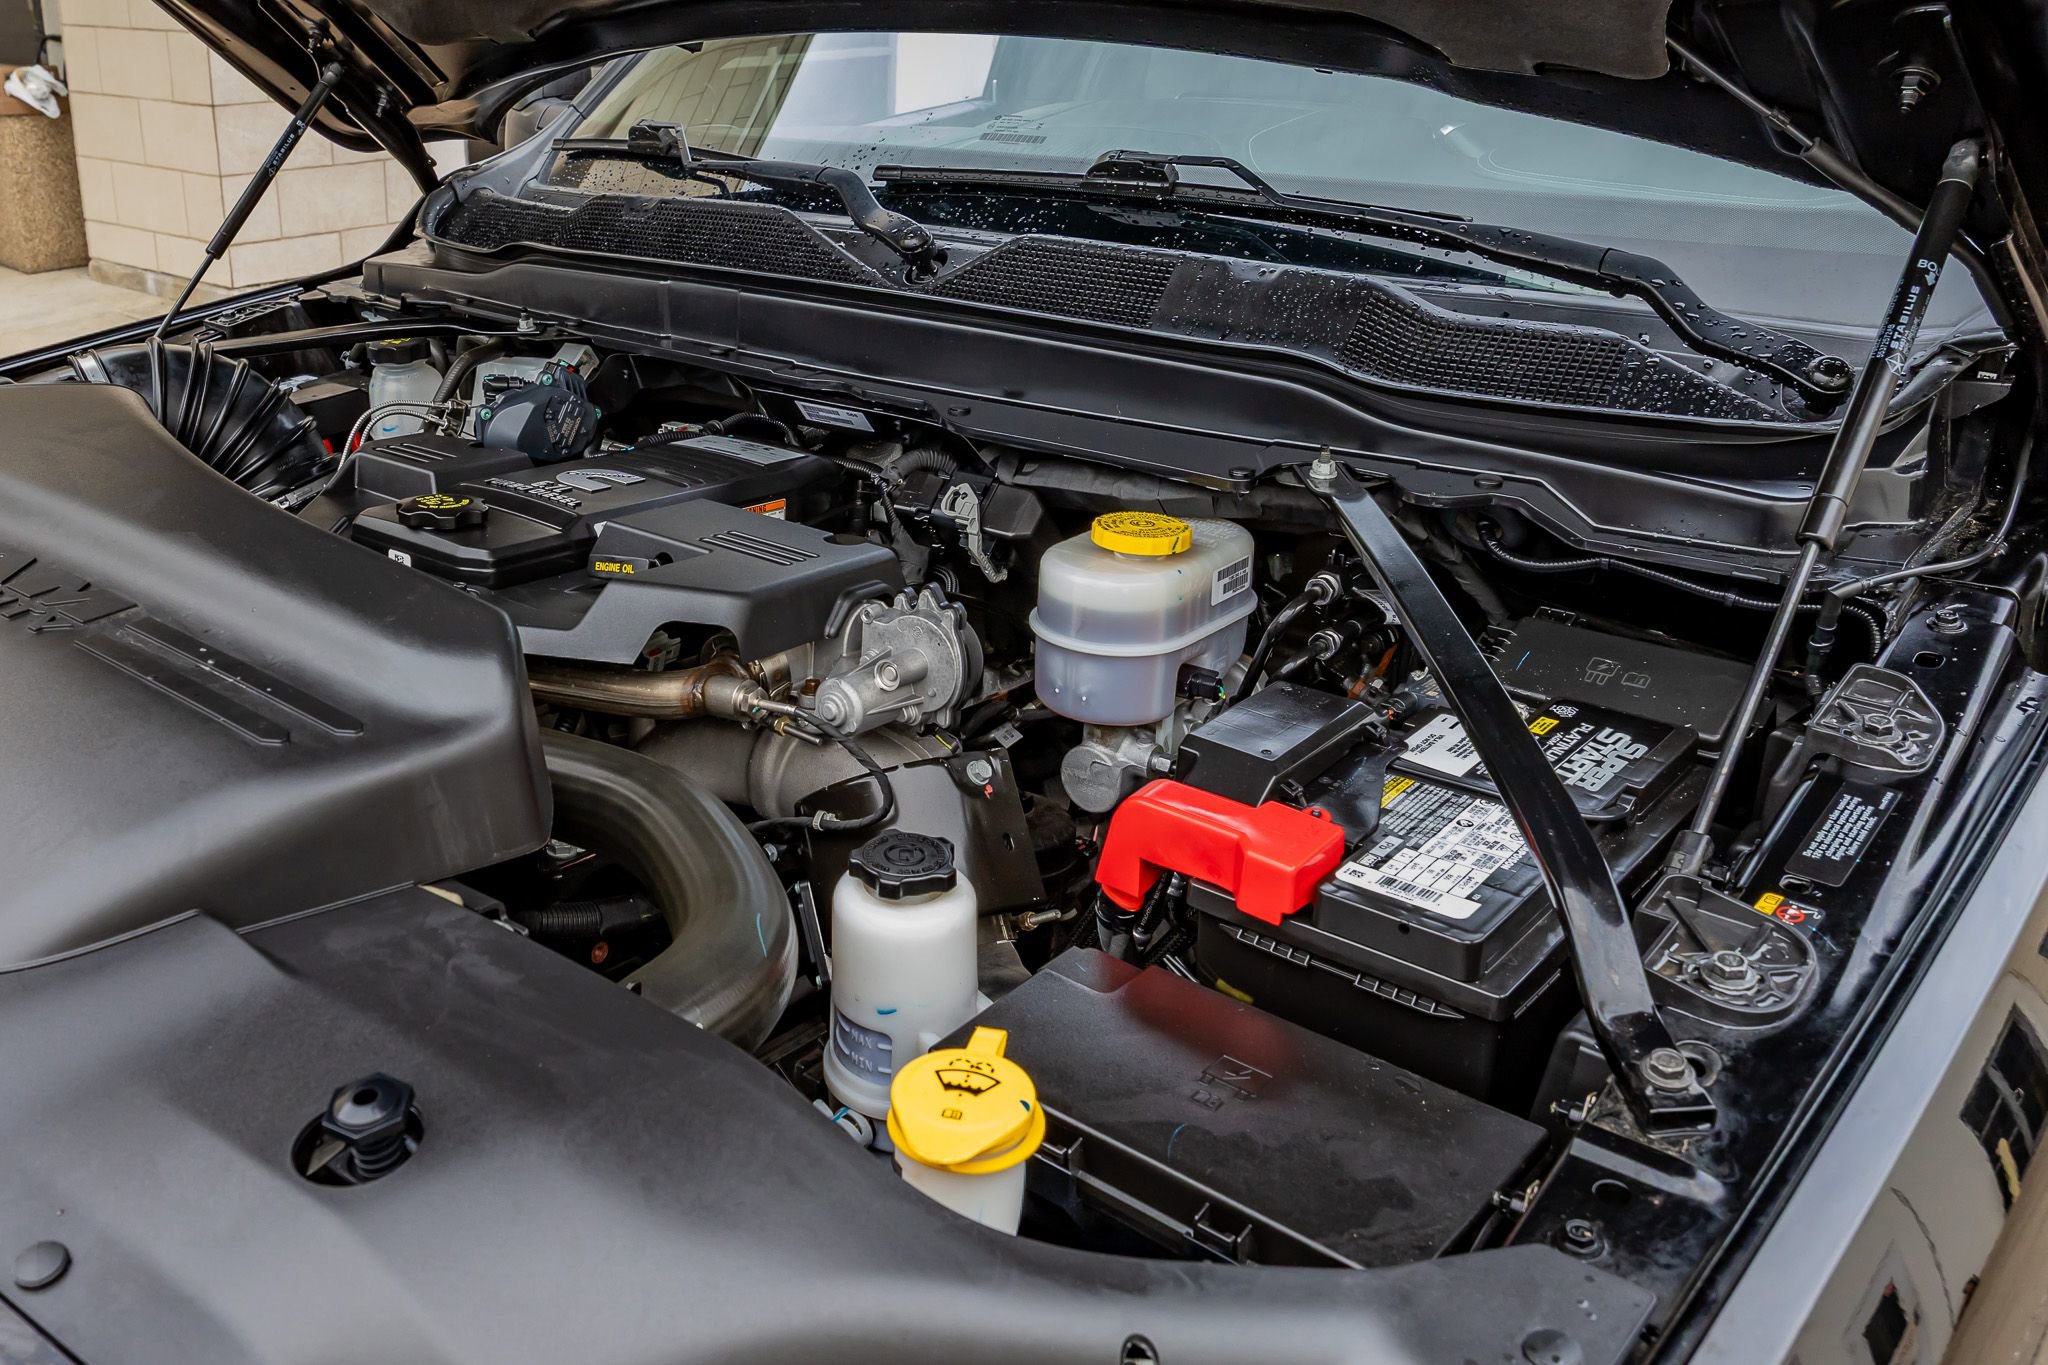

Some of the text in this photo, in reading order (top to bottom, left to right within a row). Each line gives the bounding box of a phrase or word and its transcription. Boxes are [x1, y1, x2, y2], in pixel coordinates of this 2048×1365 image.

[1890, 285, 1920, 350] STABILUS
[527, 488, 582, 506] DIESEL
[594, 561, 635, 574] ENGINE OIL
[1545, 722, 1595, 762] PLATINU
[1554, 726, 1632, 786] START
[1574, 742, 1649, 792] SUPER
[1812, 848, 1824, 859] 12V
[851, 1028, 872, 1049] MAX
[851, 1051, 873, 1073] MIN
